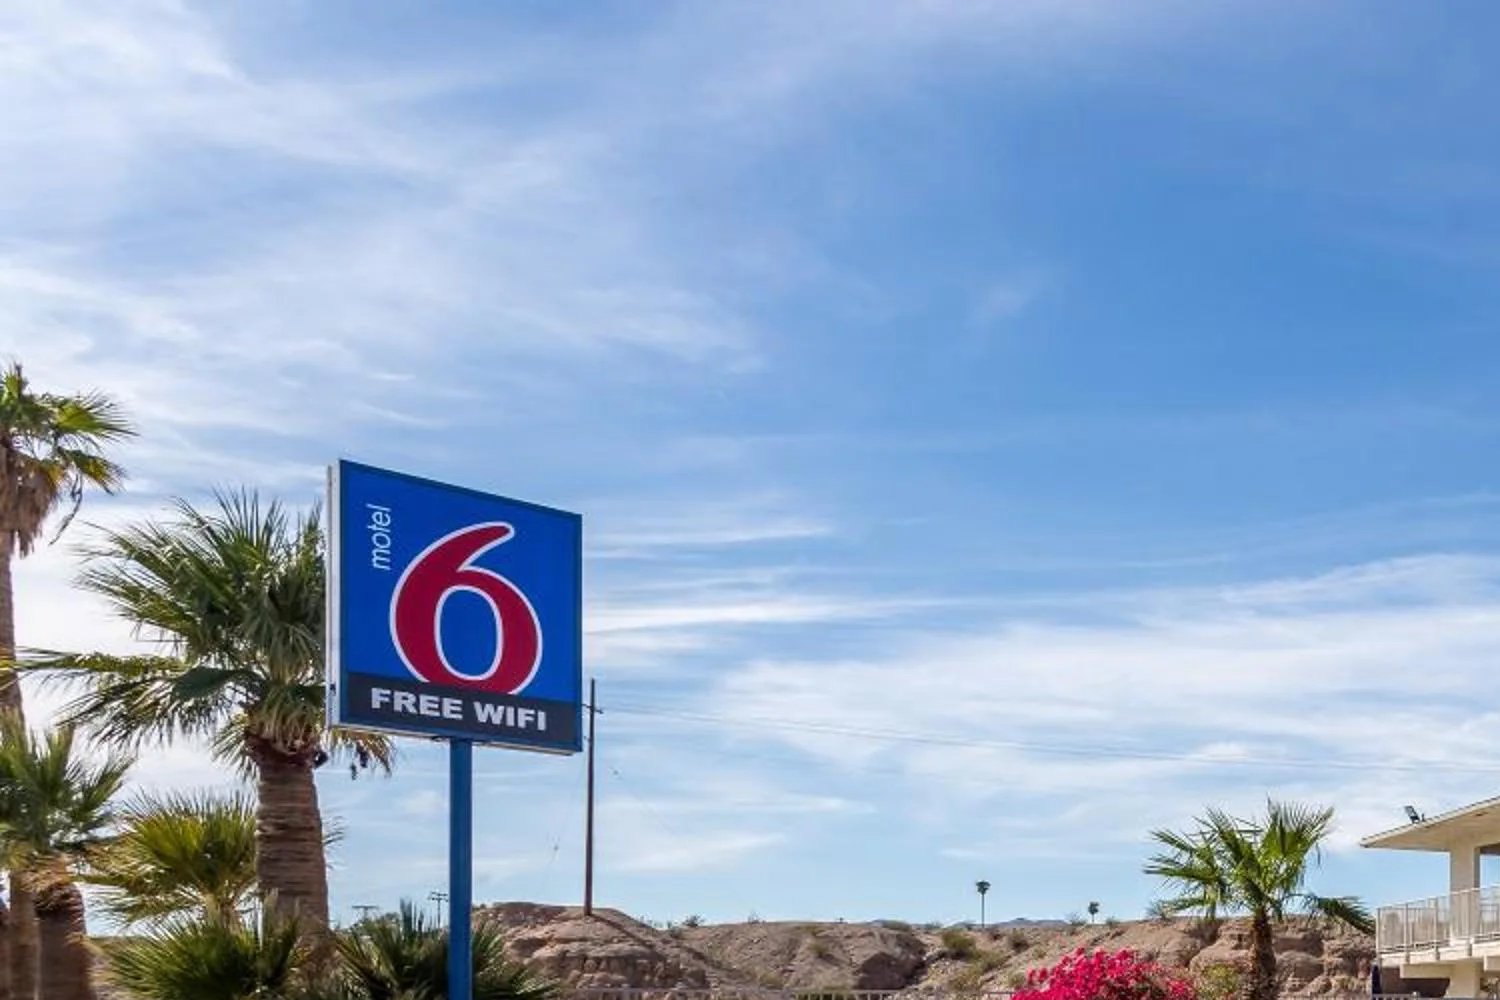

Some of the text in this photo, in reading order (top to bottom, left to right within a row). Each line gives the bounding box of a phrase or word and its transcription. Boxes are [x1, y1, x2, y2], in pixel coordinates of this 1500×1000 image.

[366, 503, 391, 570] motel
[389, 521, 543, 695] 6
[371, 687, 547, 731] FREE WIFI
